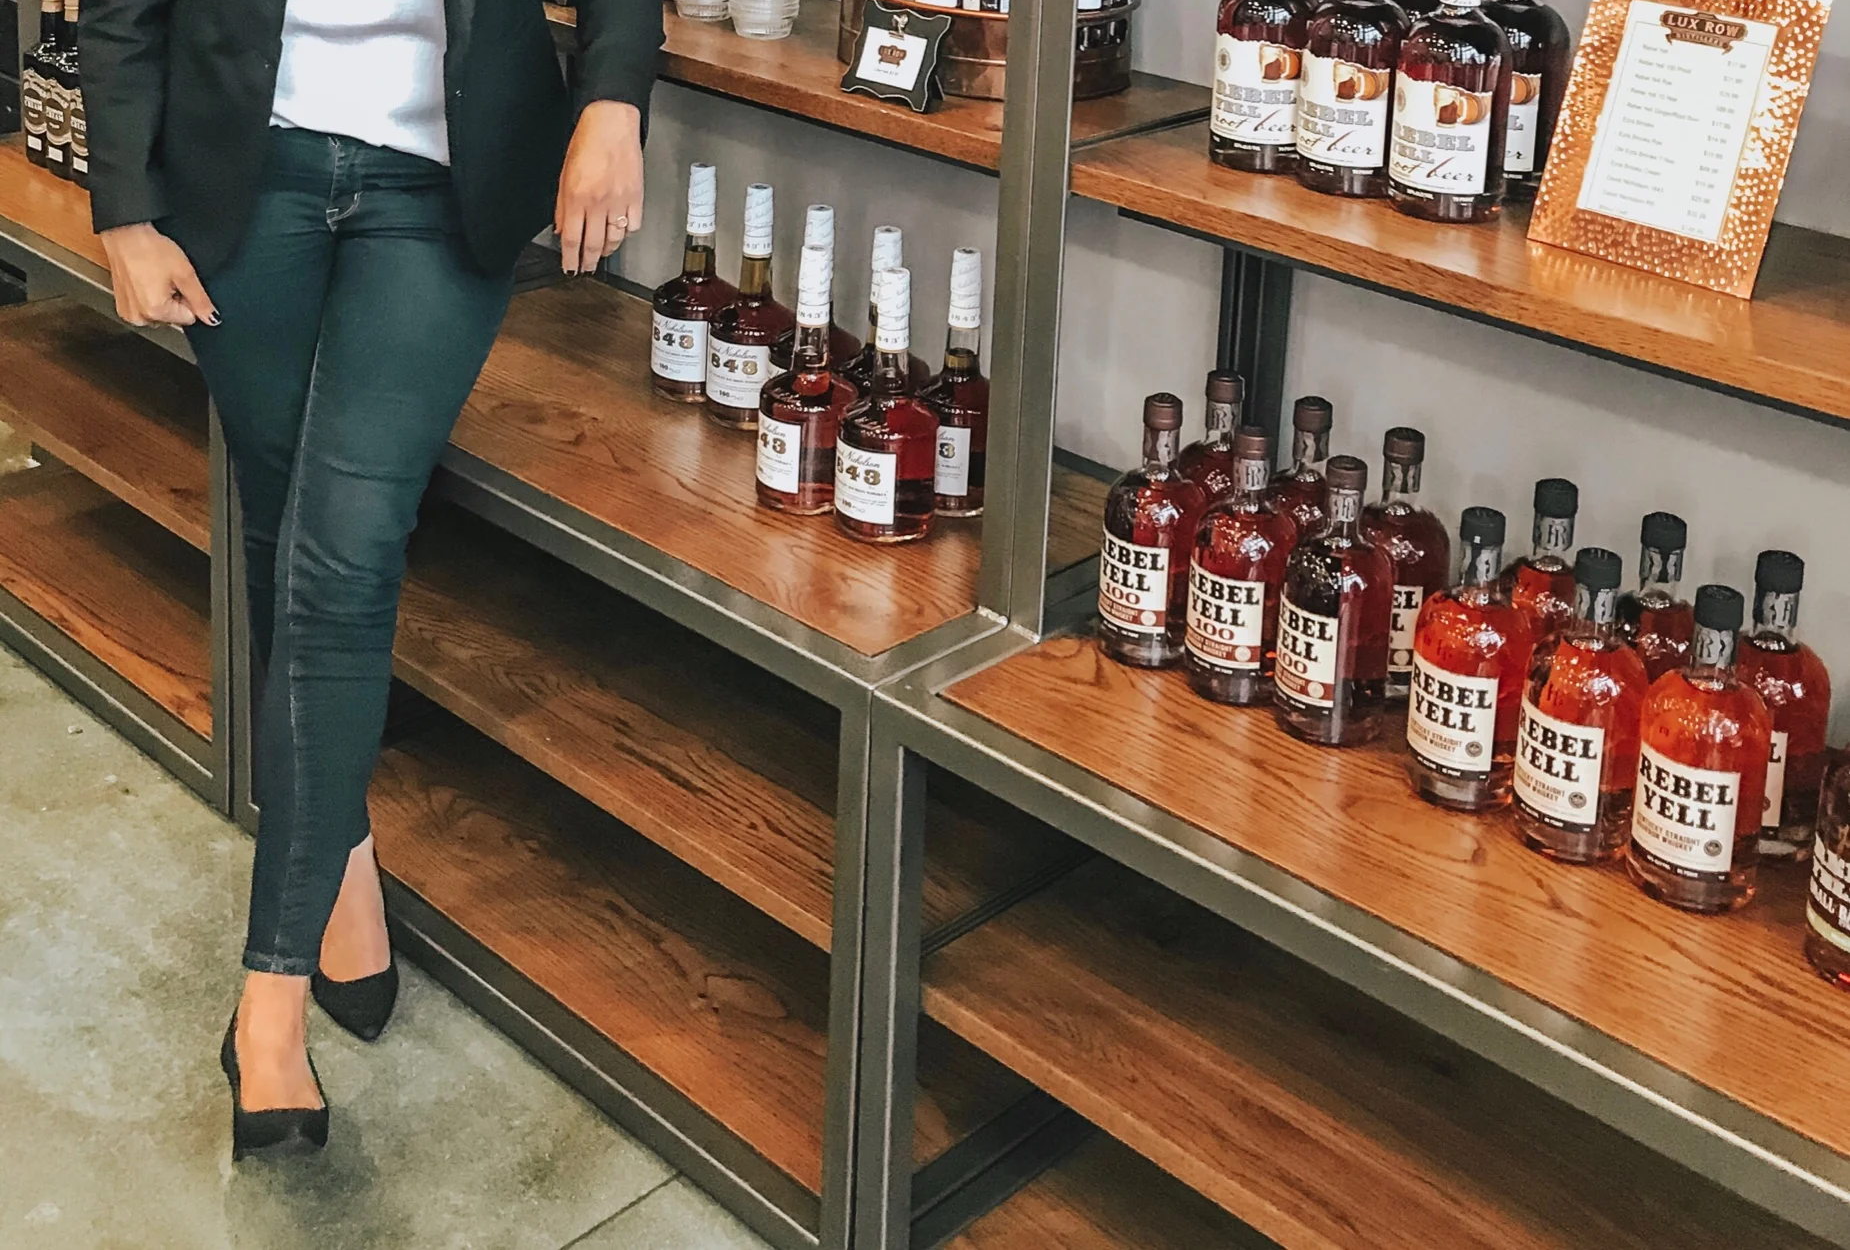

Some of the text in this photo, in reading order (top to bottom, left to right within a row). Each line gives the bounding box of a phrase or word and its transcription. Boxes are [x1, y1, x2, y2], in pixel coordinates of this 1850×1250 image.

[1667, 14, 1740, 38] LUX ROW
[1253, 109, 1297, 132] beer
[1327, 130, 1375, 155] beer
[1426, 156, 1476, 182] beer
[843, 450, 880, 468] Nicholson
[1105, 537, 1165, 571] EBEL
[1103, 555, 1150, 592] YELL
[1190, 564, 1260, 606] REBEL
[1105, 582, 1140, 604] 100
[1191, 590, 1245, 627] YELL
[1195, 617, 1235, 641] 100
[1281, 601, 1333, 642] EBEL
[1281, 628, 1318, 662] ELL
[1412, 661, 1493, 710] REBEL
[1415, 690, 1476, 733] YELL
[1520, 706, 1597, 760] REBEL
[1520, 734, 1580, 783] YELL
[1639, 752, 1734, 806] REBEL
[1643, 784, 1716, 831] YELL
[1662, 836, 1694, 852] WHISKEY
[1665, 830, 1701, 846] STRAIGHT
